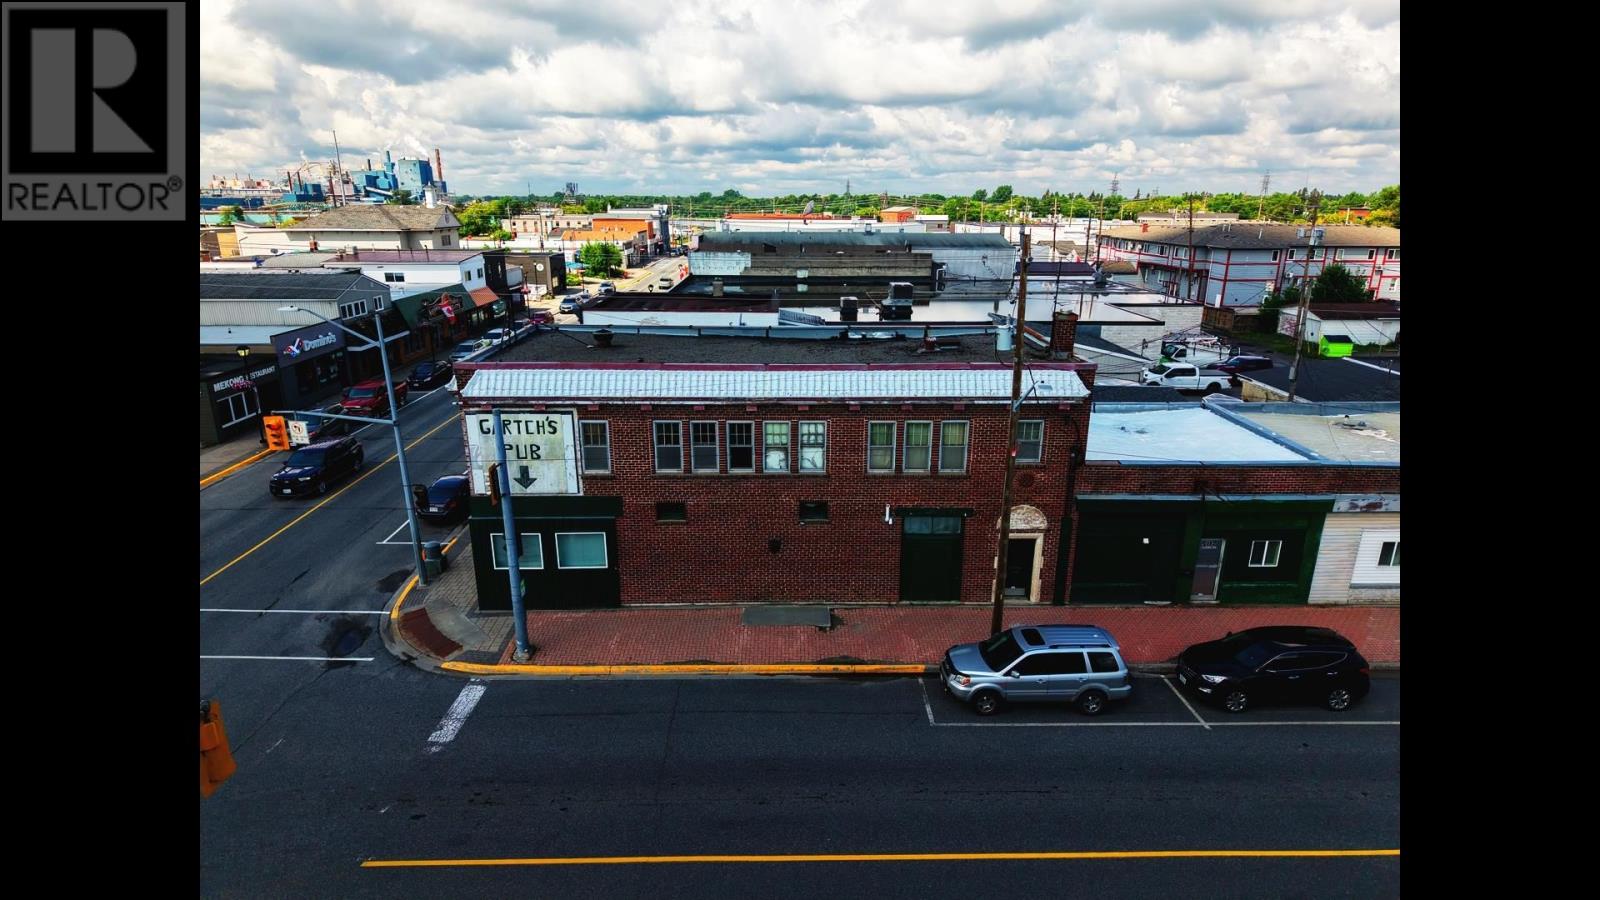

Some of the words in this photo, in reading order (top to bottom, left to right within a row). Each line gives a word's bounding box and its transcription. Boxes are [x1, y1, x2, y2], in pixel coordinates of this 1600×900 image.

[303, 331, 337, 351] Domino's
[213, 375, 245, 392] MEKONG
[479, 416, 558, 435] GRTCH'S
